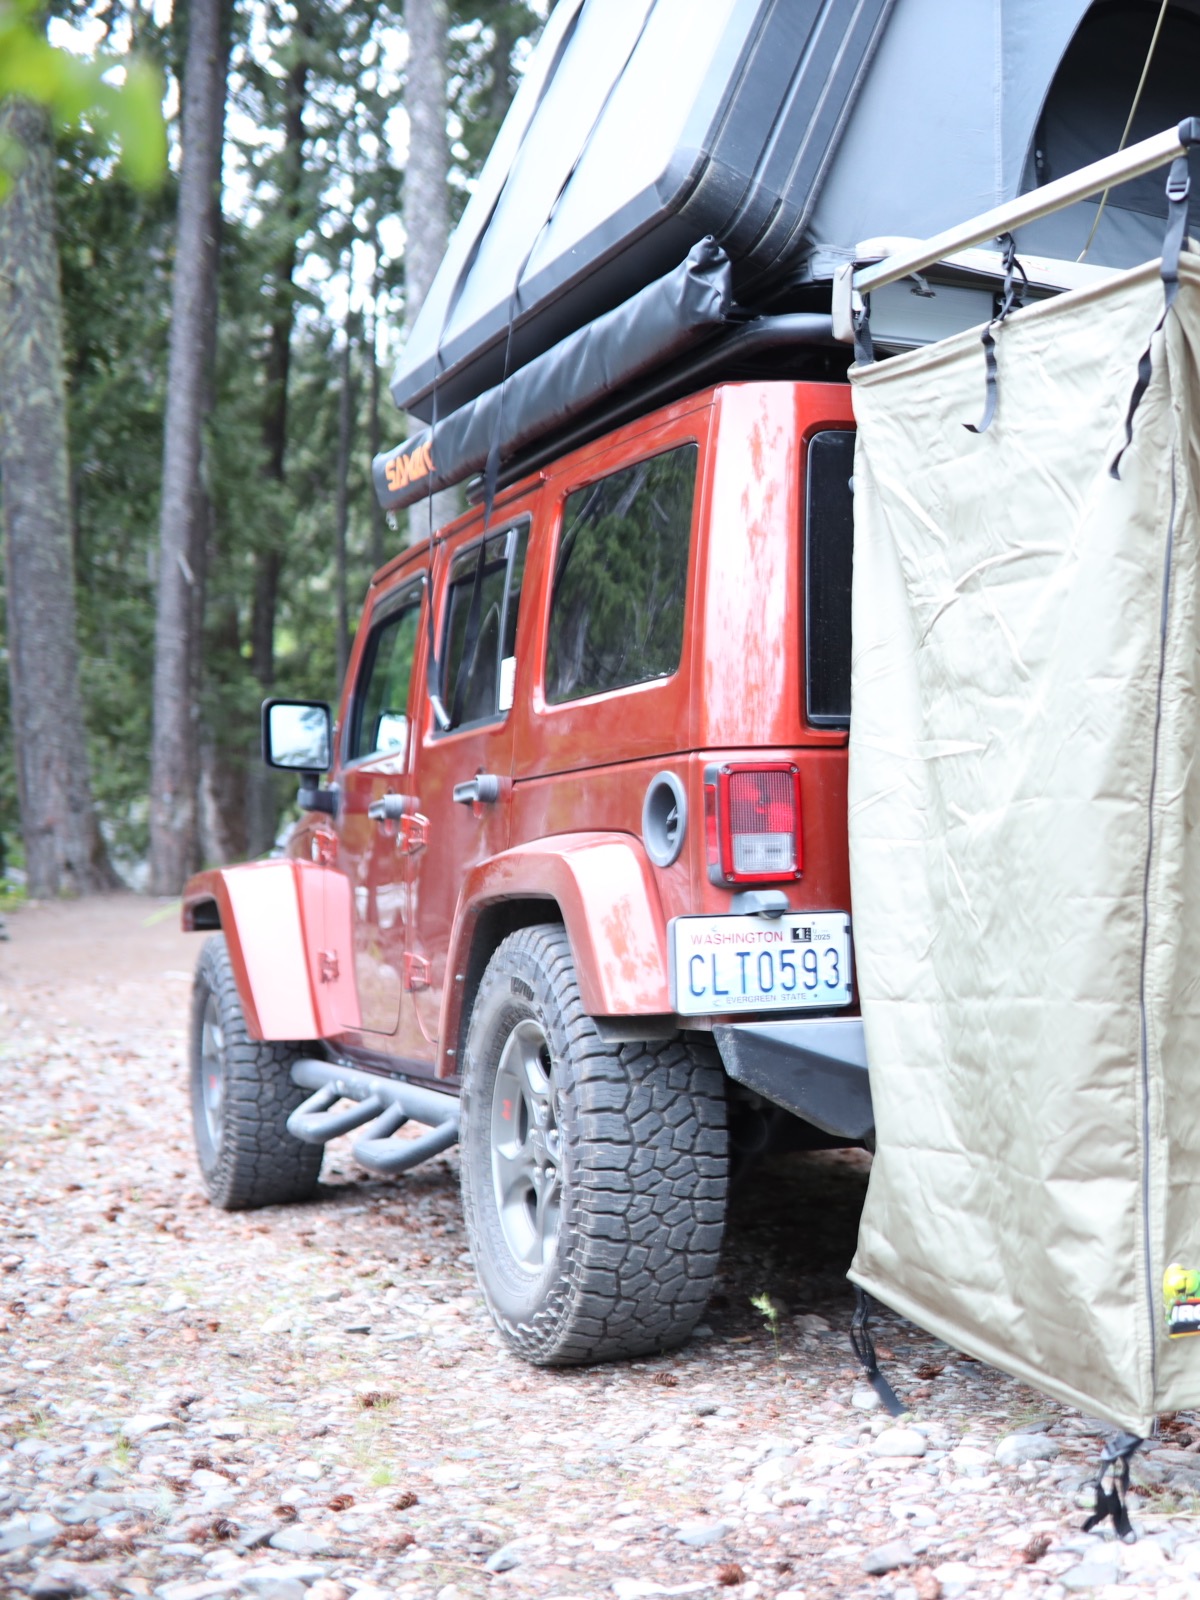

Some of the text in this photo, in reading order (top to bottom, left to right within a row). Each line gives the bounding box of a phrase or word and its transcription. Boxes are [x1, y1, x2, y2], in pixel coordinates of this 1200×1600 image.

[691, 931, 783, 945] WASHINGTON
[689, 947, 840, 997] CLT0593
[726, 993, 807, 1004] EVERGREEN STATE
